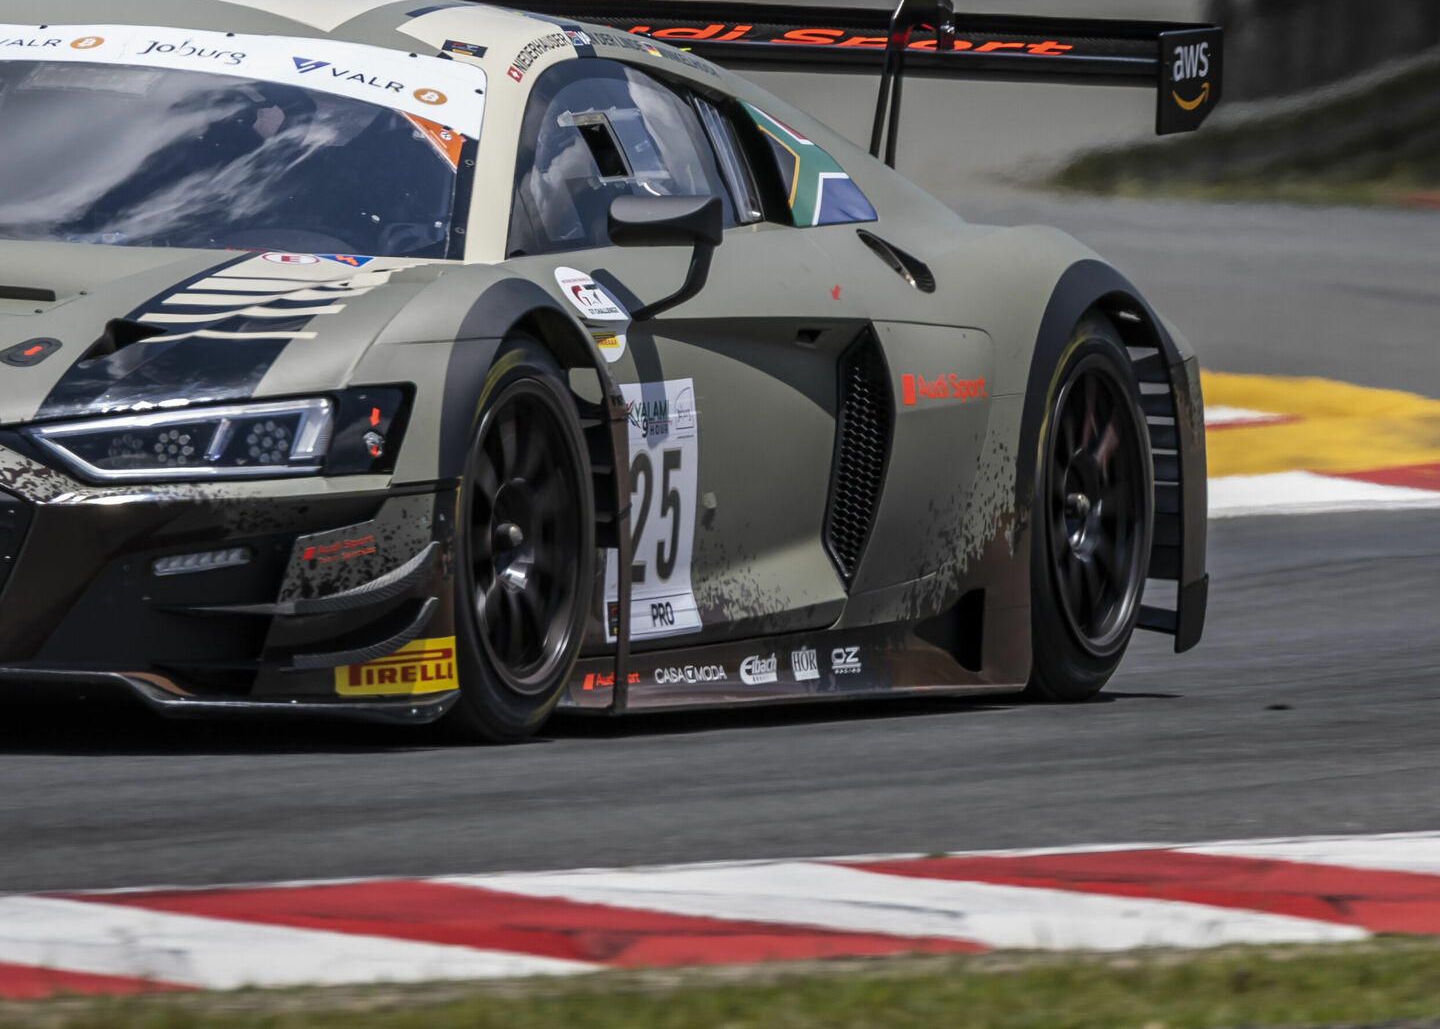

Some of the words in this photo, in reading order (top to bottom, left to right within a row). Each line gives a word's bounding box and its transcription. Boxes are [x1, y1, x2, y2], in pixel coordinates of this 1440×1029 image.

[1173, 41, 1209, 81] aws
[331, 67, 405, 93] VALR
[918, 374, 949, 399] Audi
[949, 373, 987, 404] Sport
[630, 447, 682, 584] 25
[651, 602, 675, 627] PRO
[348, 648, 453, 687] PIRELLI
[831, 646, 860, 664] OZ
